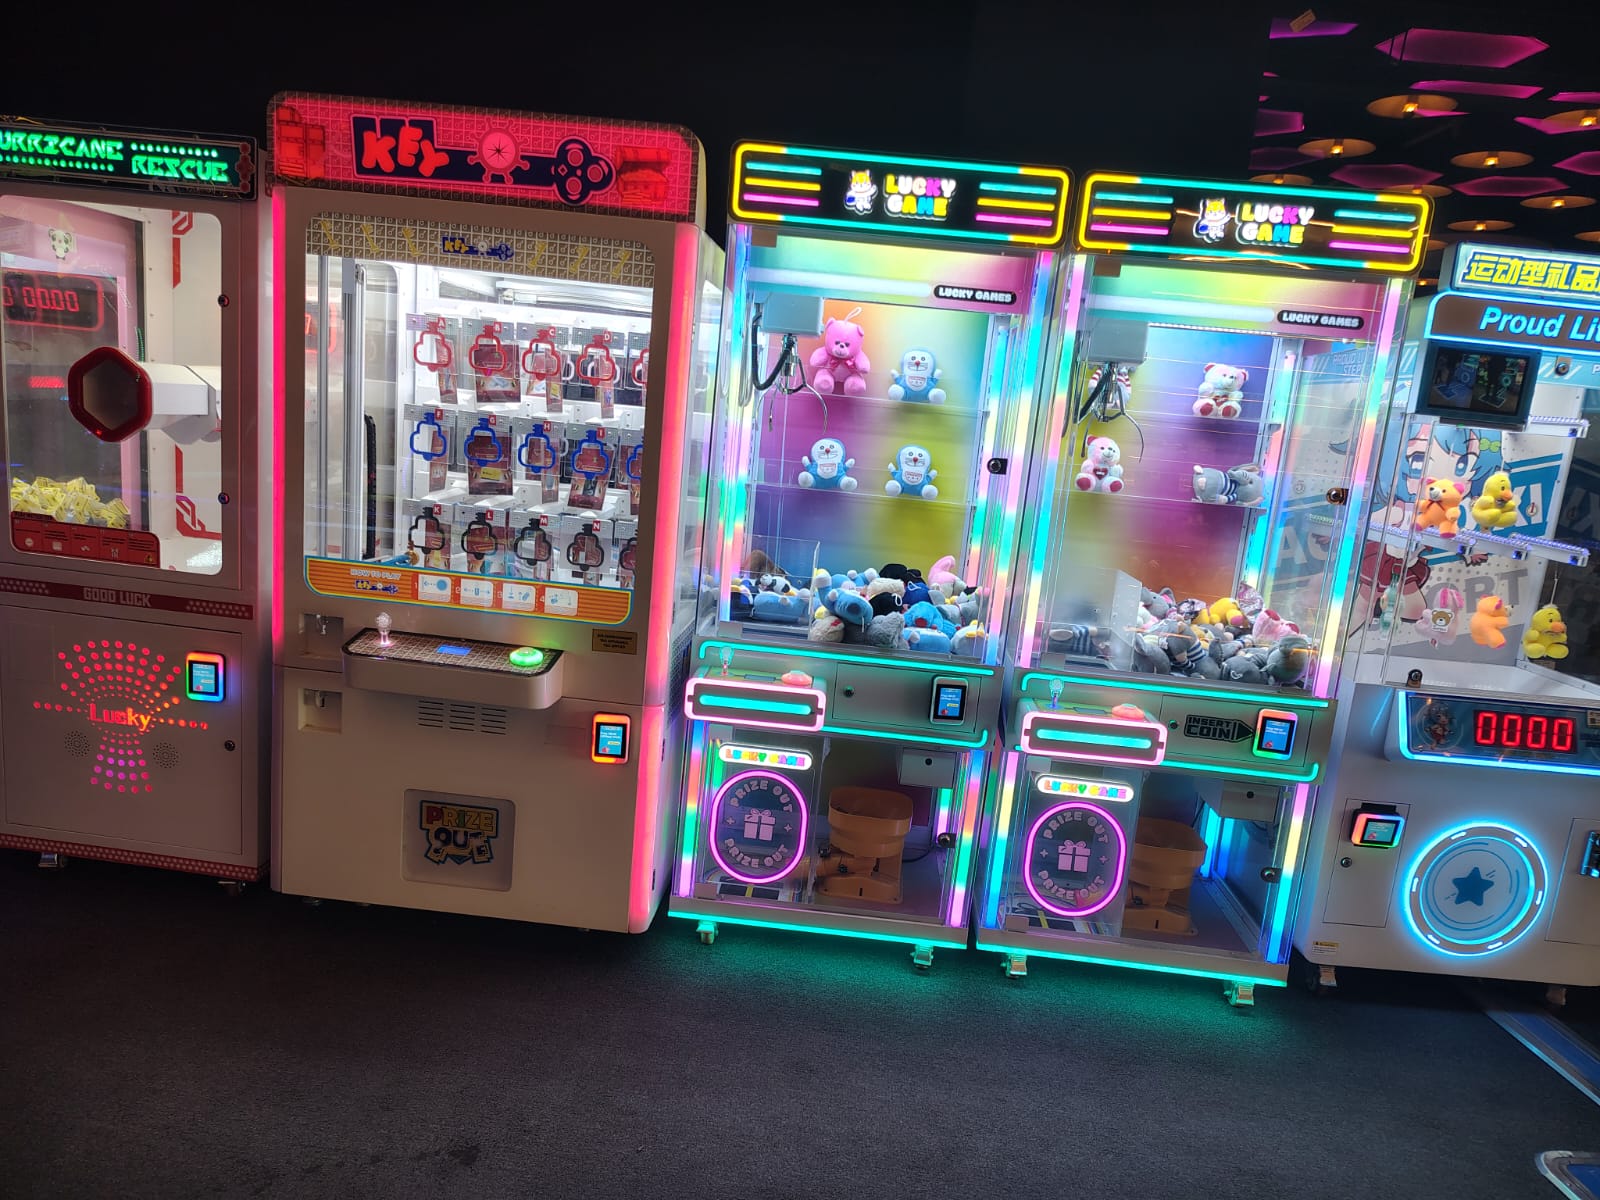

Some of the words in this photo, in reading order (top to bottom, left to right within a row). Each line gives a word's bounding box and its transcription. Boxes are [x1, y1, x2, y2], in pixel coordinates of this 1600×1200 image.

[361, 126, 449, 177] KEY
[131, 154, 230, 182] RESCUE
[885, 173, 957, 198] LUCKY
[886, 194, 948, 217] GAME
[1241, 202, 1315, 226] LUCKY
[444, 238, 470, 253] KEY
[1241, 222, 1305, 244] GAME
[1464, 254, 1600, 293] 运动型礼品
[938, 286, 974, 299] LUCKY
[975, 290, 1012, 303] GAMES
[1281, 311, 1319, 325] LUCKY
[1320, 315, 1359, 328] GAMES
[1479, 306, 1567, 338] Proud
[83, 587, 118, 603] GOOD
[119, 590, 151, 607] LUCK
[89, 702, 151, 731] Lucky
[1188, 716, 1233, 728] INSERT
[1186, 724, 1232, 740] COIN
[1475, 711, 1573, 752] 0000
[730, 780, 769, 807] PRIZE
[772, 786, 793, 812] OUT
[425, 806, 495, 832] PRIZE
[1043, 811, 1083, 839] PRIZE
[1087, 816, 1109, 843] OUT
[725, 838, 760, 868] PRIZE
[1038, 870, 1075, 900] PRIZE
